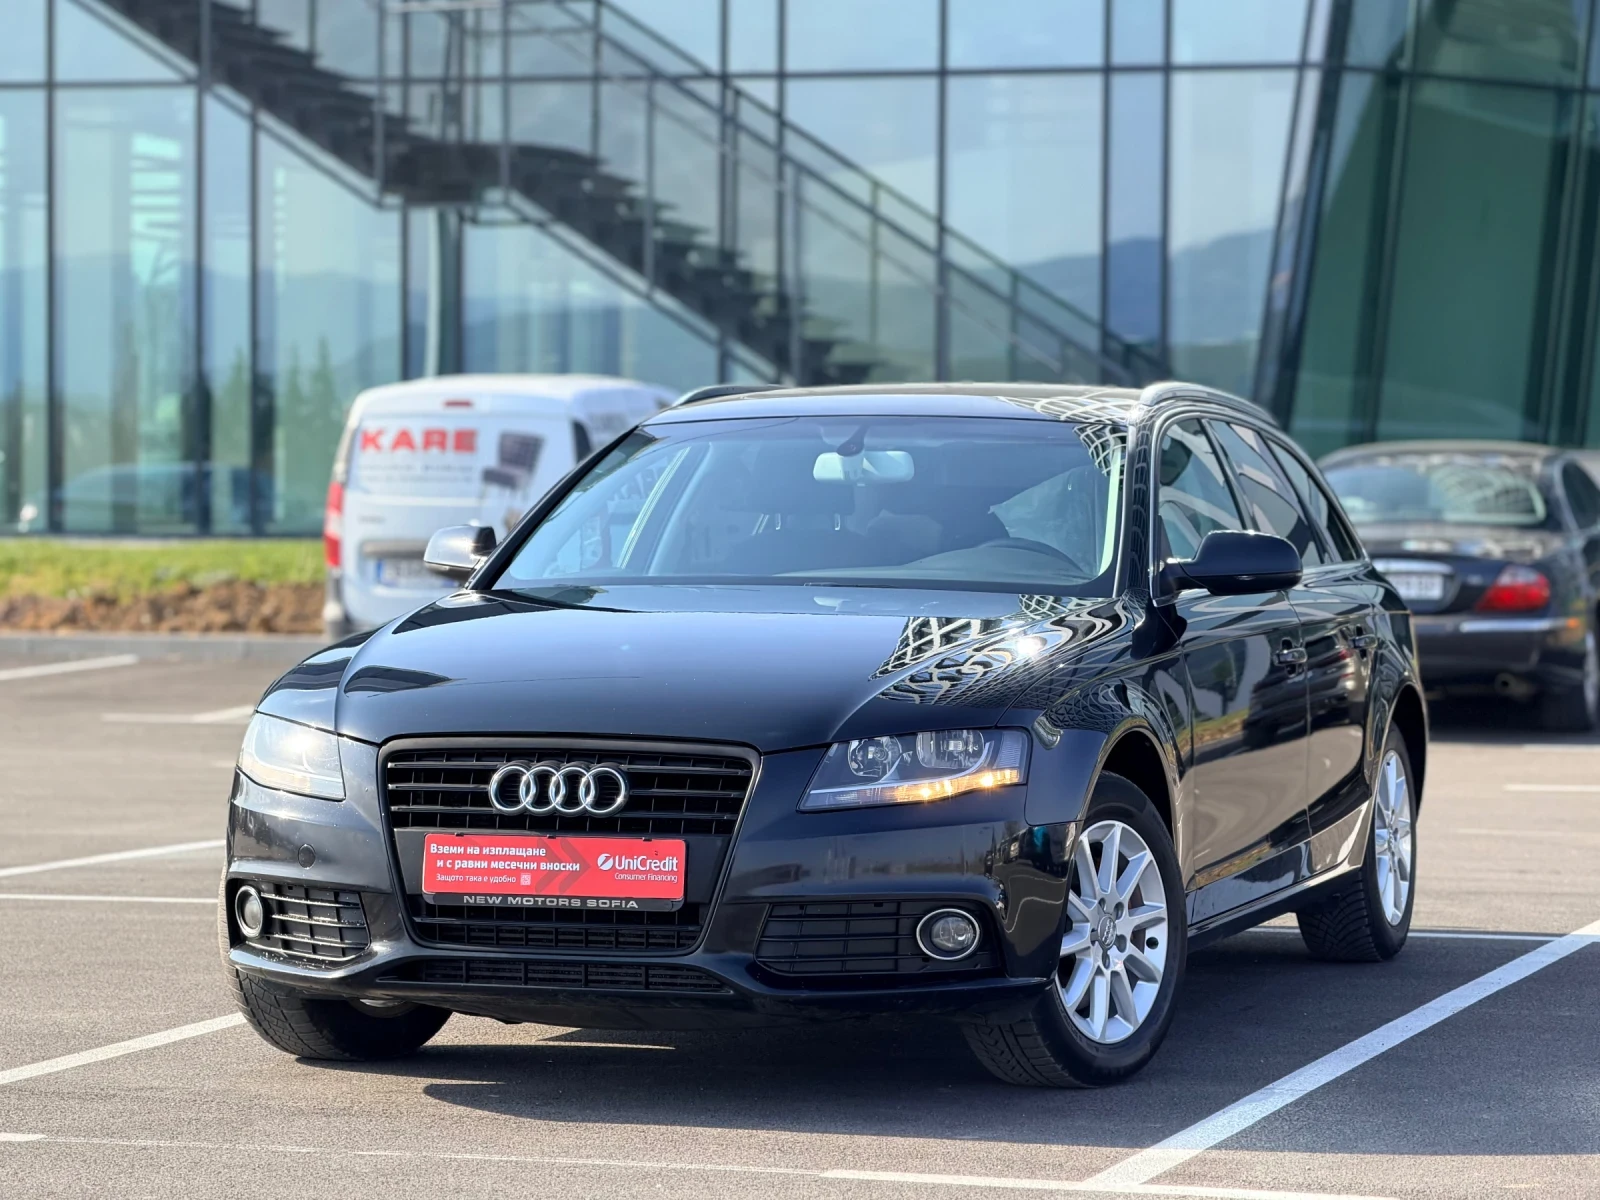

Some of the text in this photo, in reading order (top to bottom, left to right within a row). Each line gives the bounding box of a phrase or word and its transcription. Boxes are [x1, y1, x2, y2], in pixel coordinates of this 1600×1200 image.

[361, 428, 477, 453] KARE
[430, 843, 546, 856] Вземи на изплащане
[436, 860, 580, 871] и с равни месечни вноски
[615, 855, 678, 871] UniCredit
[436, 873, 464, 882] Защото
[489, 875, 516, 884] удобно
[614, 872, 677, 883] Consumer Financing
[463, 895, 638, 908] NEW MOTORS SOFIA
